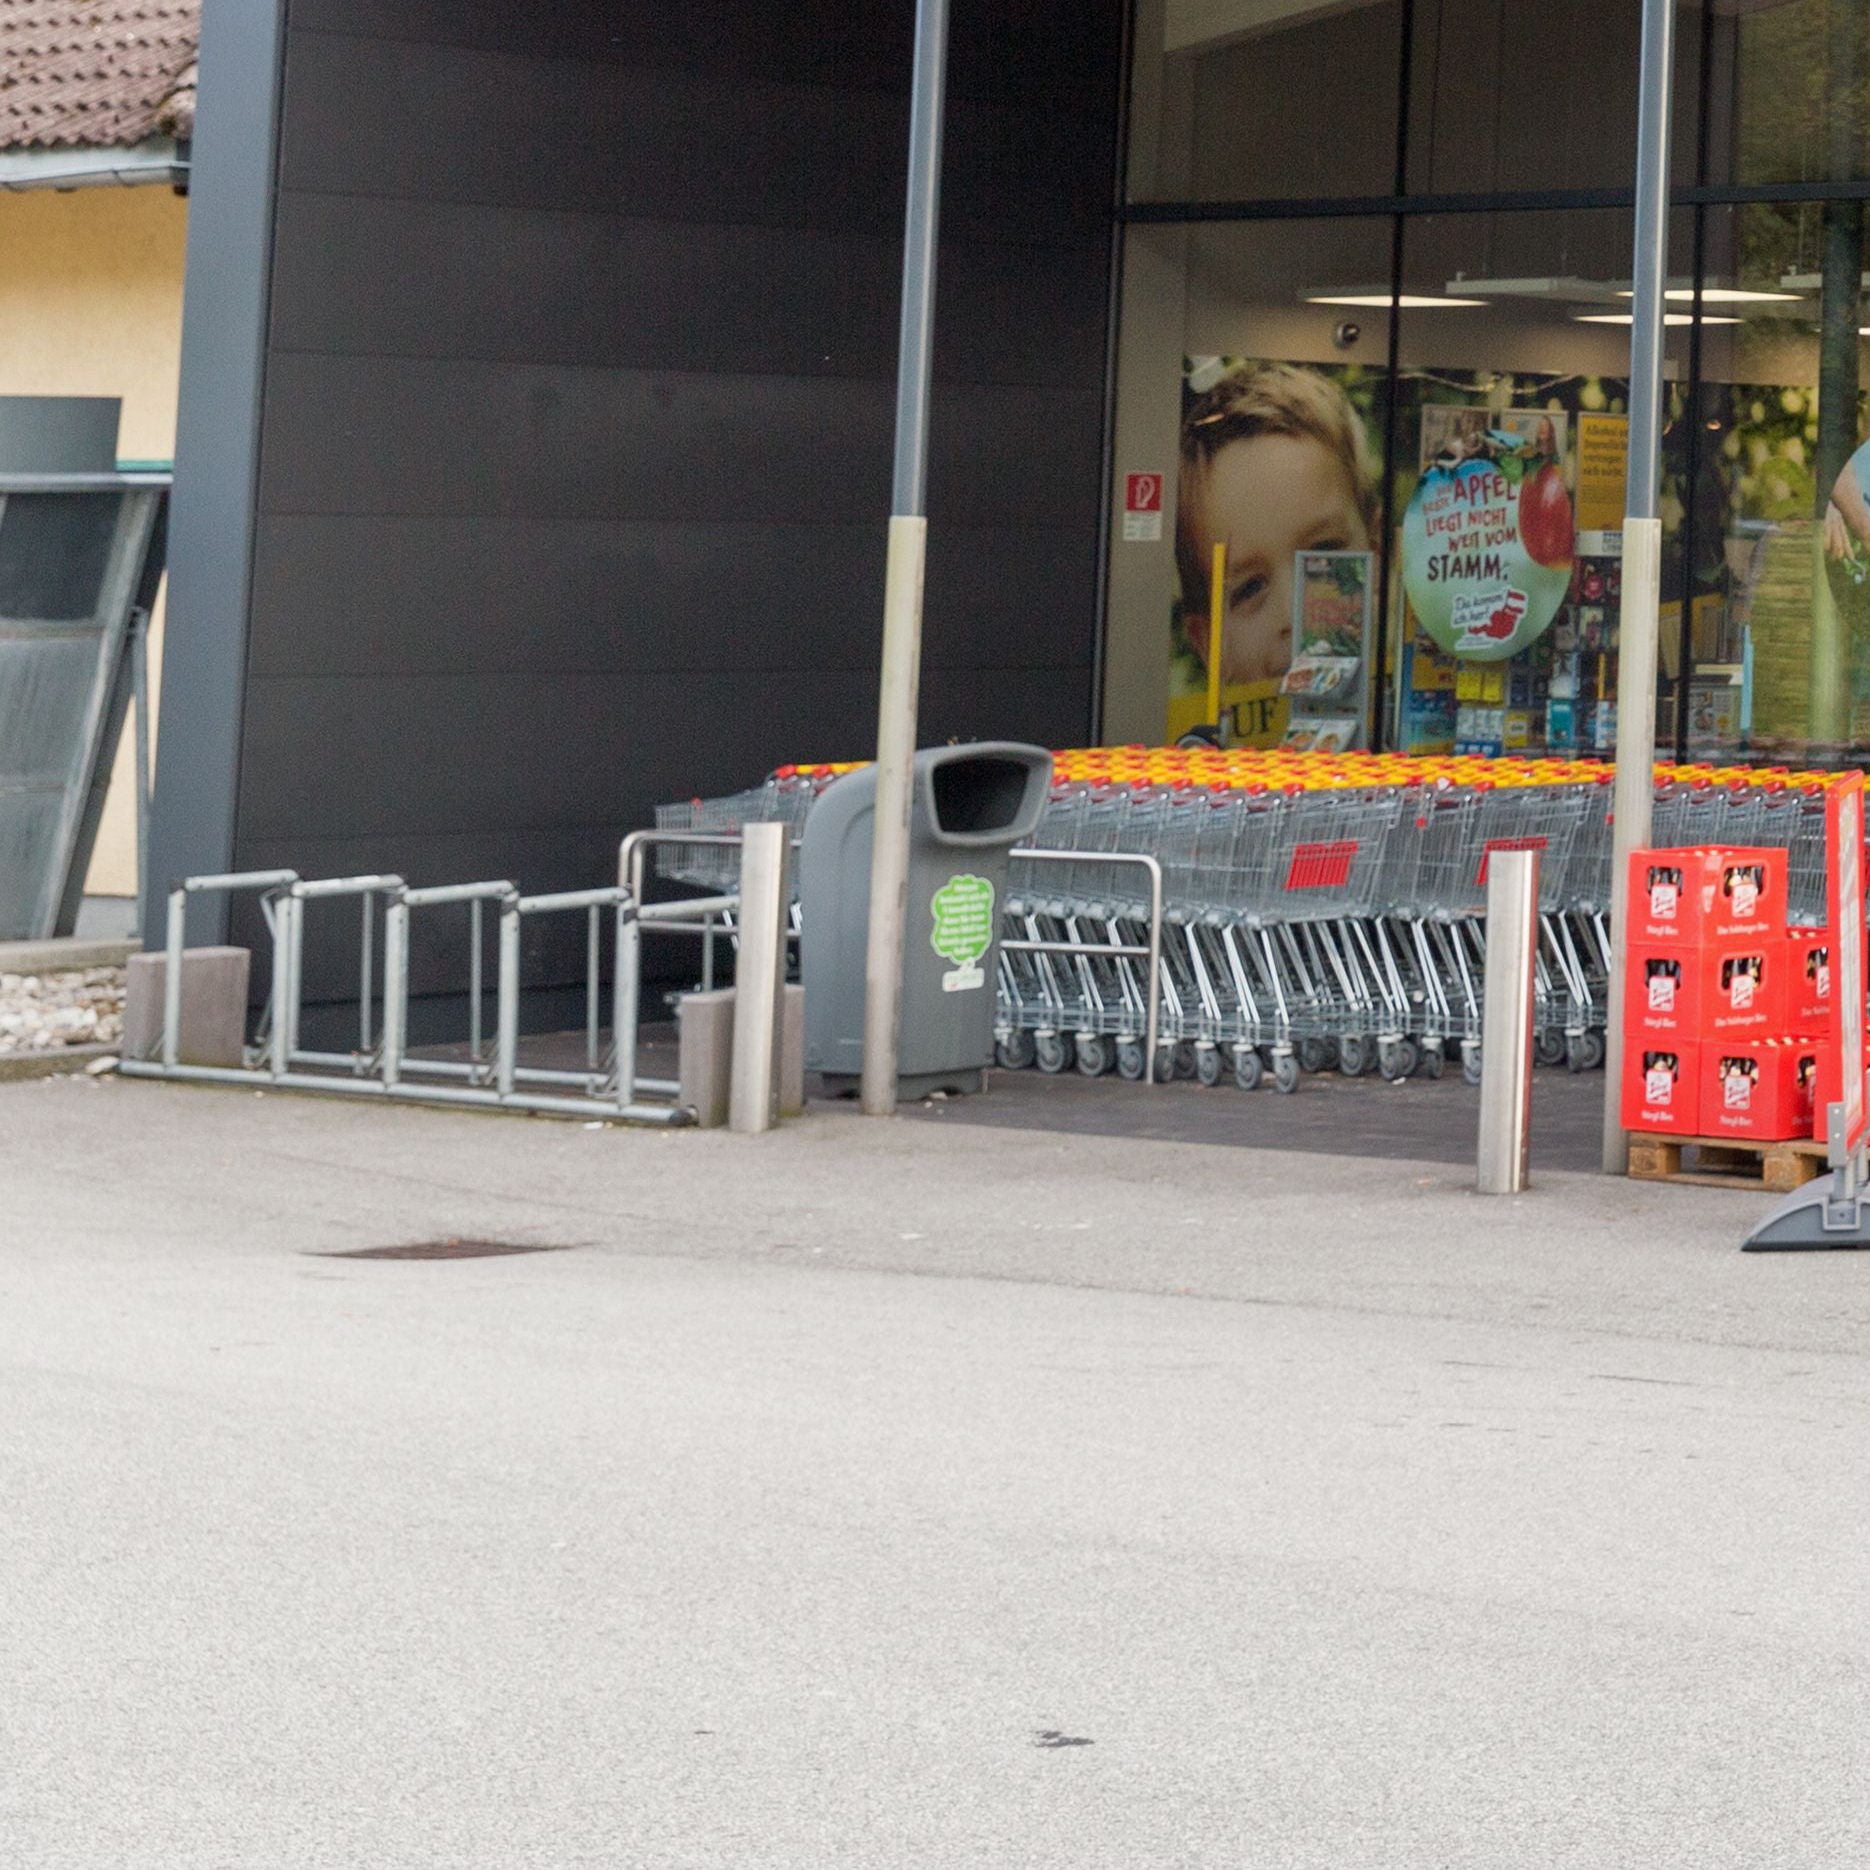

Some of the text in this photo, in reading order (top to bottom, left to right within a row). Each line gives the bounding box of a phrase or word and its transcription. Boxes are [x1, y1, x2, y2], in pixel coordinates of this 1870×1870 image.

[1453, 472, 1517, 507] APFEL
[1467, 506, 1506, 528] NICHT
[1485, 528, 1518, 548] VOM
